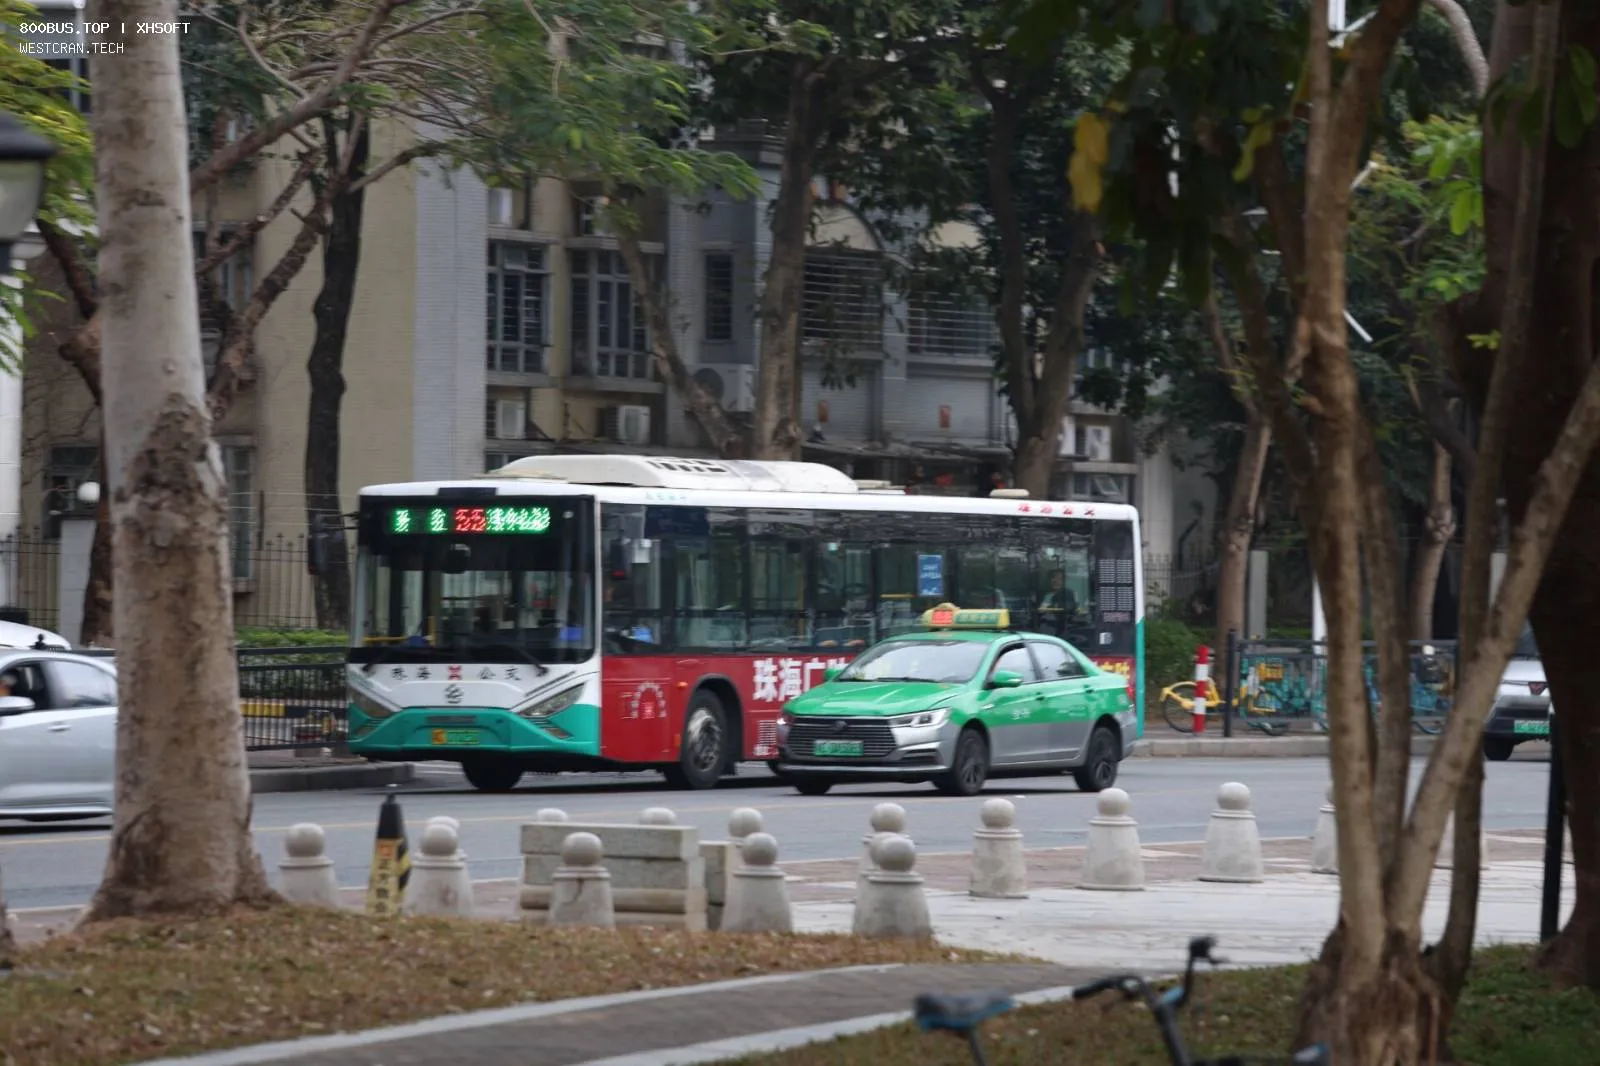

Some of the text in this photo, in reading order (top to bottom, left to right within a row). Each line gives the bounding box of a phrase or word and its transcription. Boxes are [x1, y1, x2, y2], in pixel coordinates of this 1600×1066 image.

[456, 508, 485, 532] 55
[752, 657, 850, 703] 珠海广
